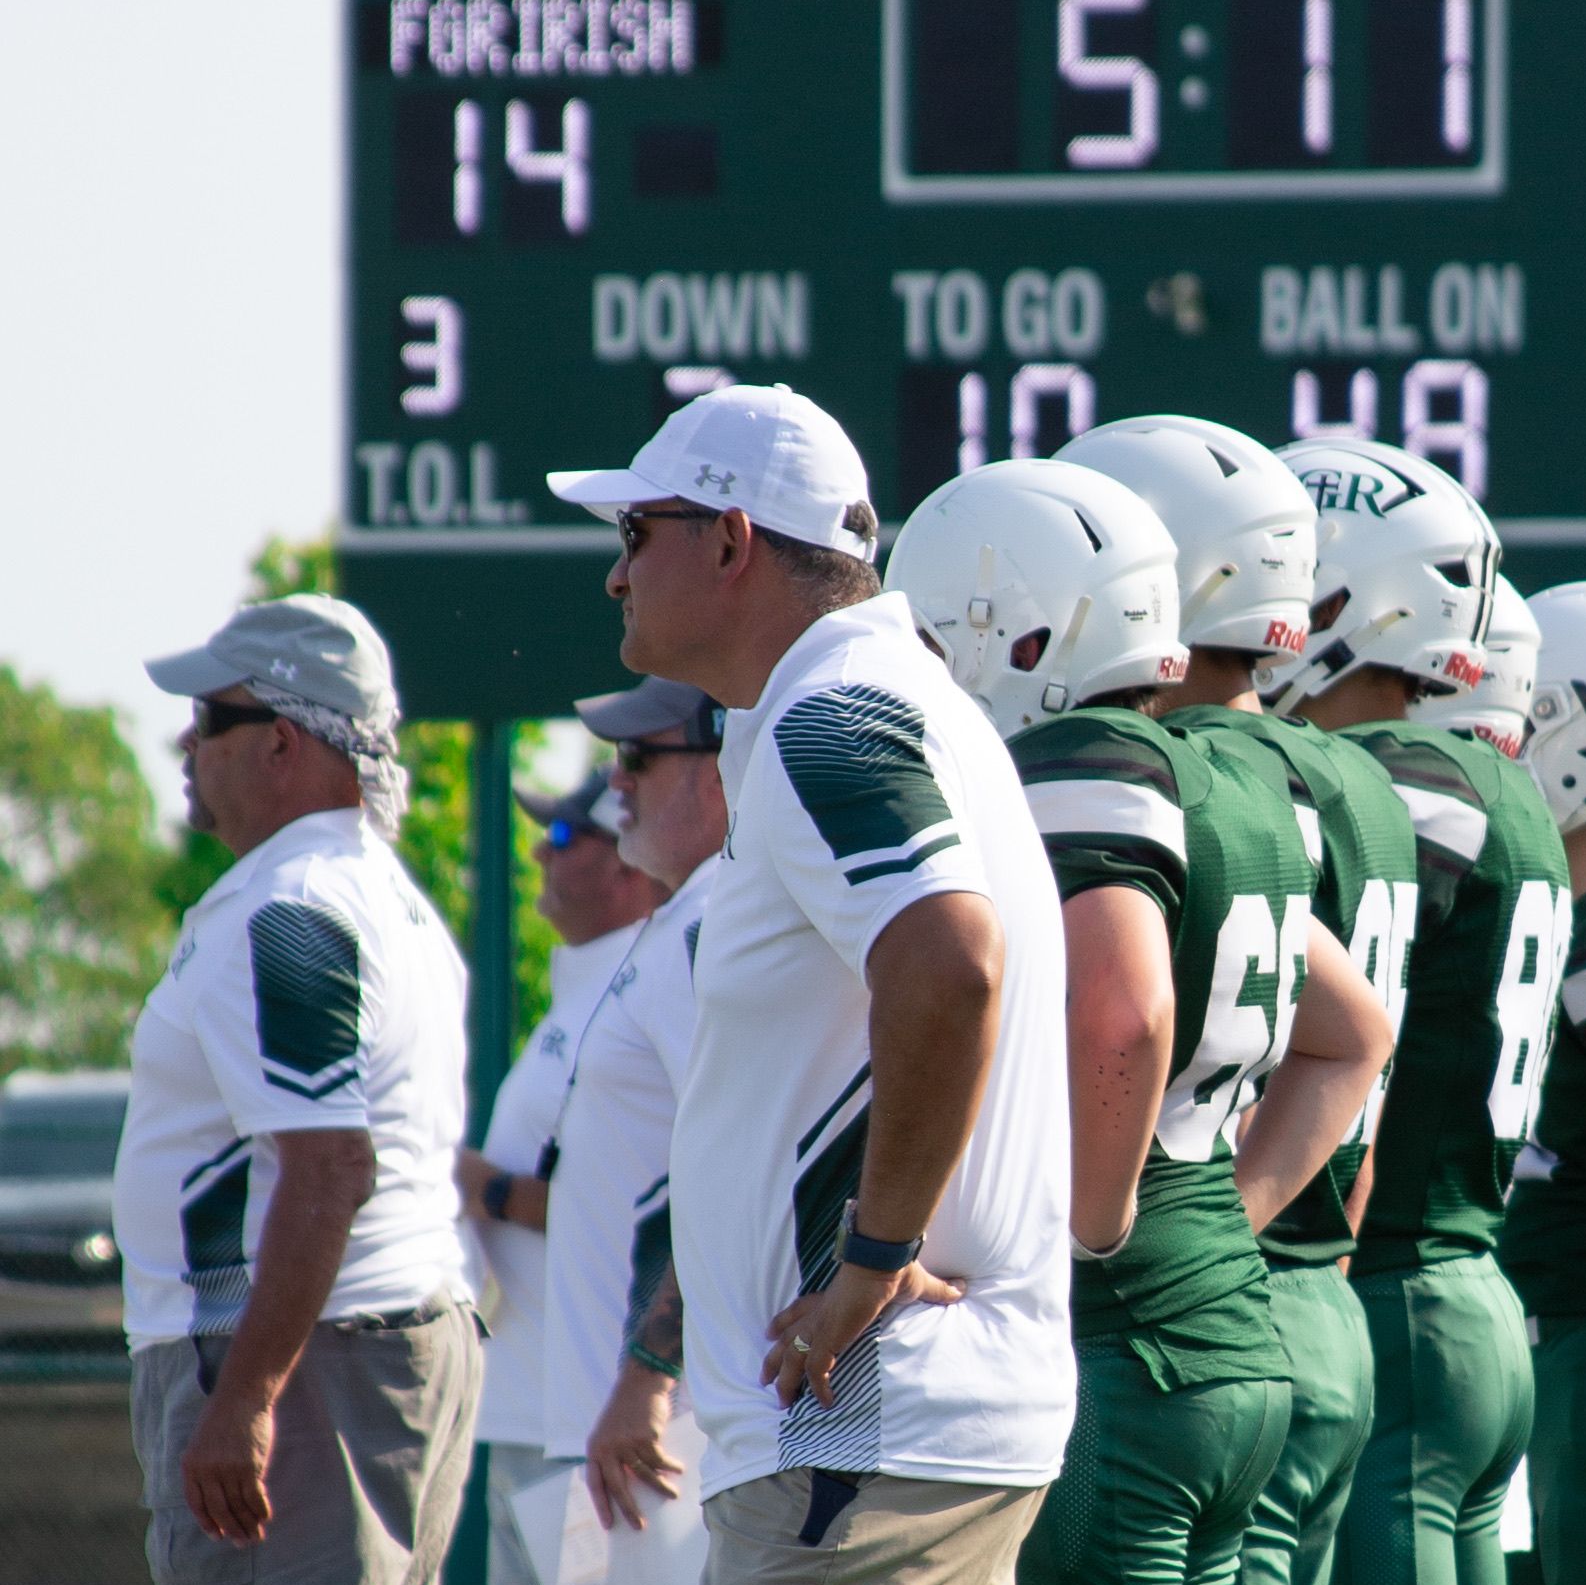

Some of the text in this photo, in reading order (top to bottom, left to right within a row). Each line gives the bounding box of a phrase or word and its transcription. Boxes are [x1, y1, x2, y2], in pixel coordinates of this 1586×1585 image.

[452, 97, 590, 233] 14
[592, 272, 808, 360] DOWN
[891, 267, 1105, 356] TO GO
[1260, 263, 1525, 353] BALL ON
[401, 294, 462, 415] 3
[358, 442, 530, 526] T.O.L.
